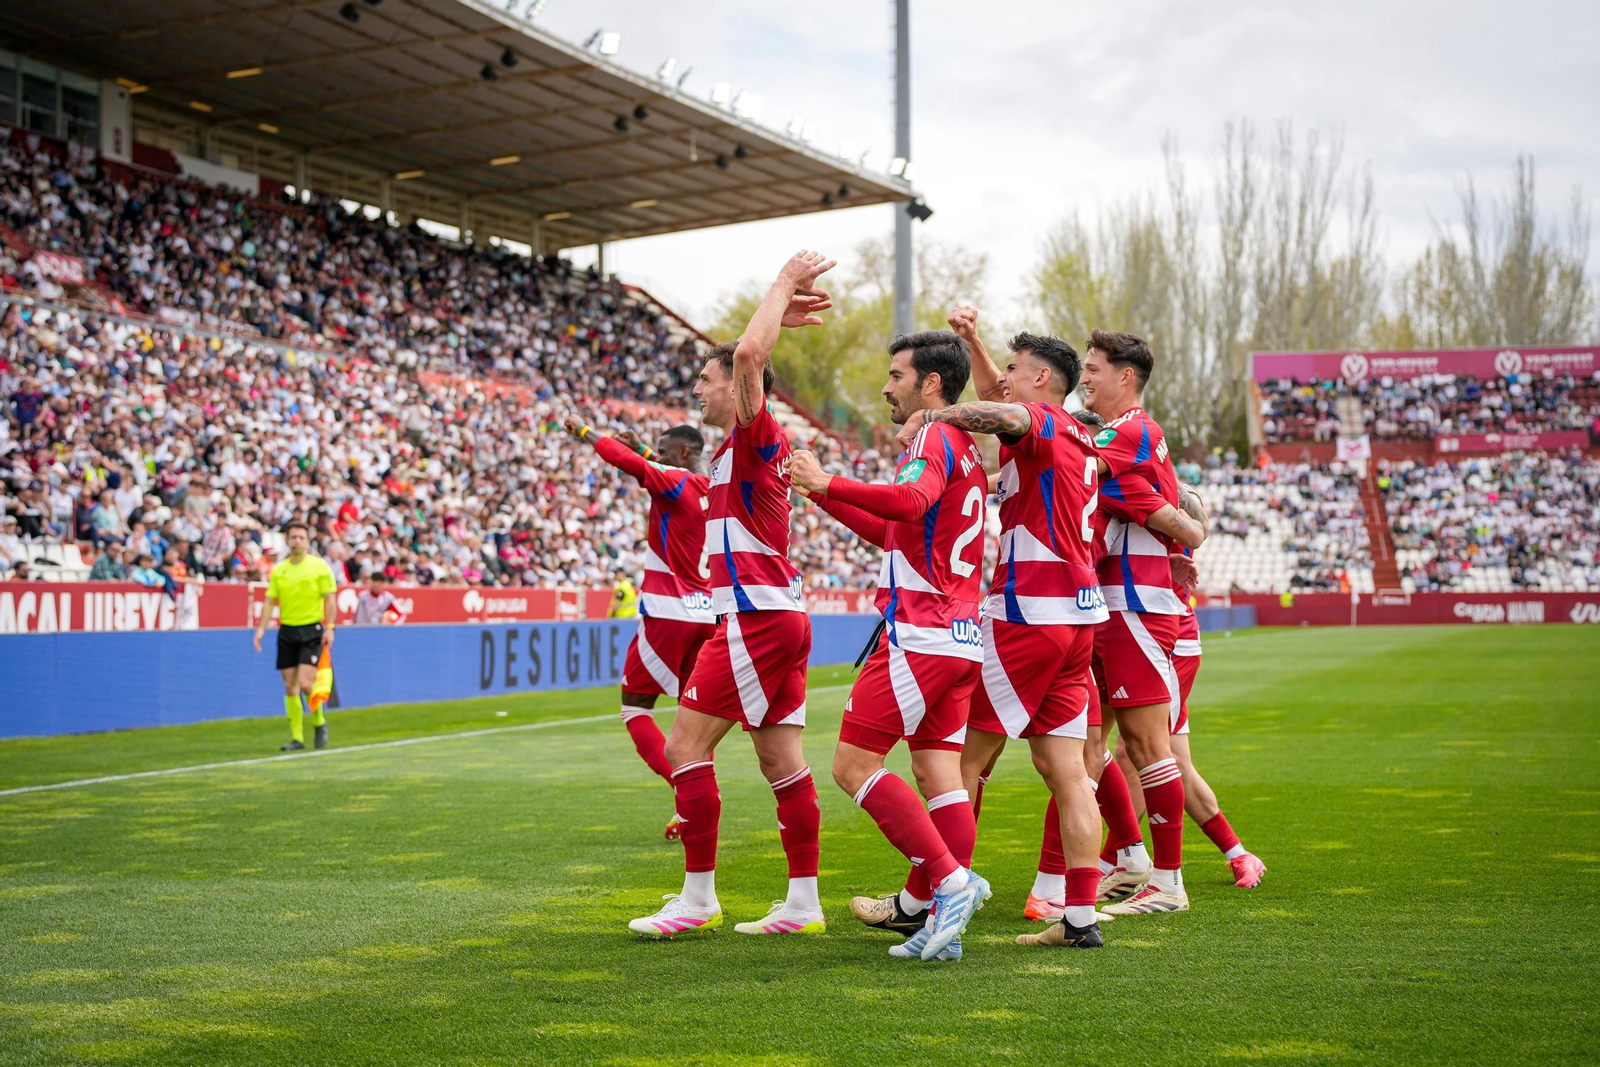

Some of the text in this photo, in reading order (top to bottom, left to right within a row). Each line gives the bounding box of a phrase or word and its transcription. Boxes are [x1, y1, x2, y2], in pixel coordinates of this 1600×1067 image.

[949, 485, 983, 578] 2
[682, 591, 713, 610] wib
[480, 625, 620, 690] DESIGNE
